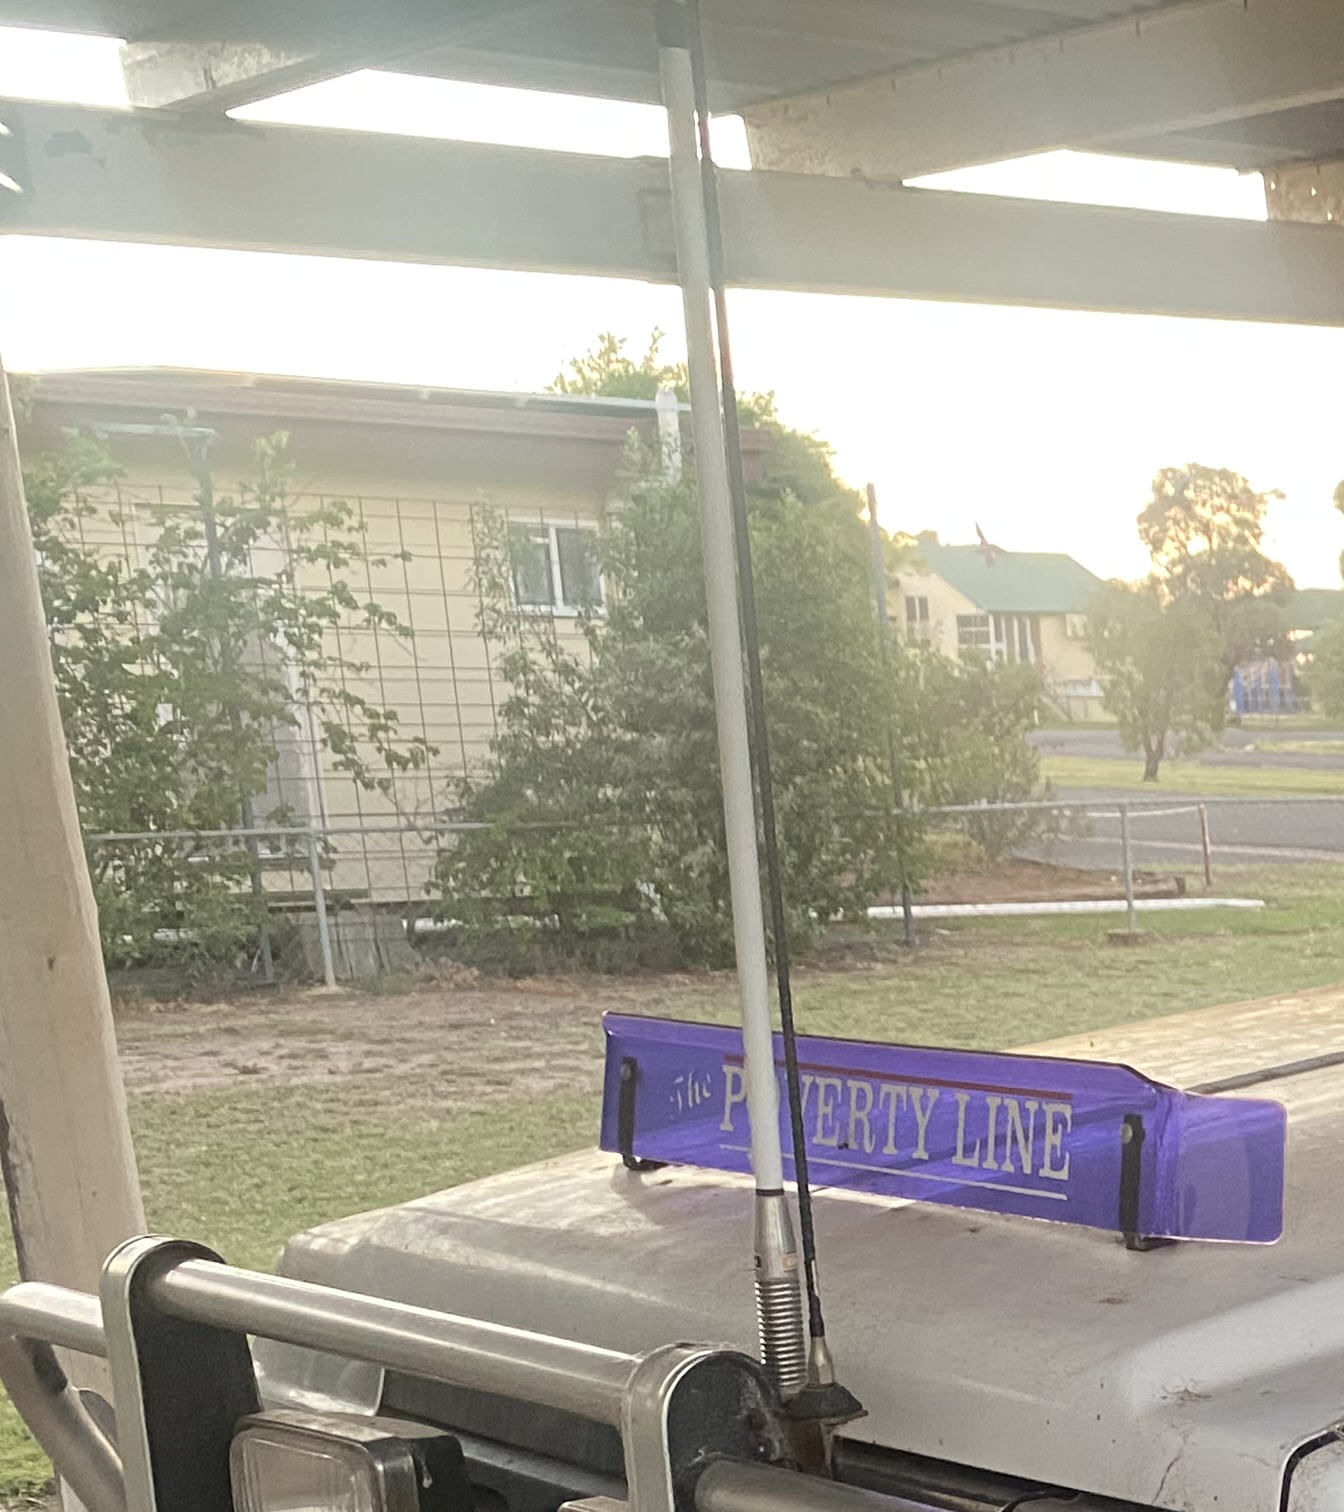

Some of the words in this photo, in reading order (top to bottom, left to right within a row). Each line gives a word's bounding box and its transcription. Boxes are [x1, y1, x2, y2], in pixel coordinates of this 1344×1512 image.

[668, 1069, 712, 1119] The
[719, 1063, 939, 1160] PVERTY
[952, 1092, 1072, 1180] LINE
